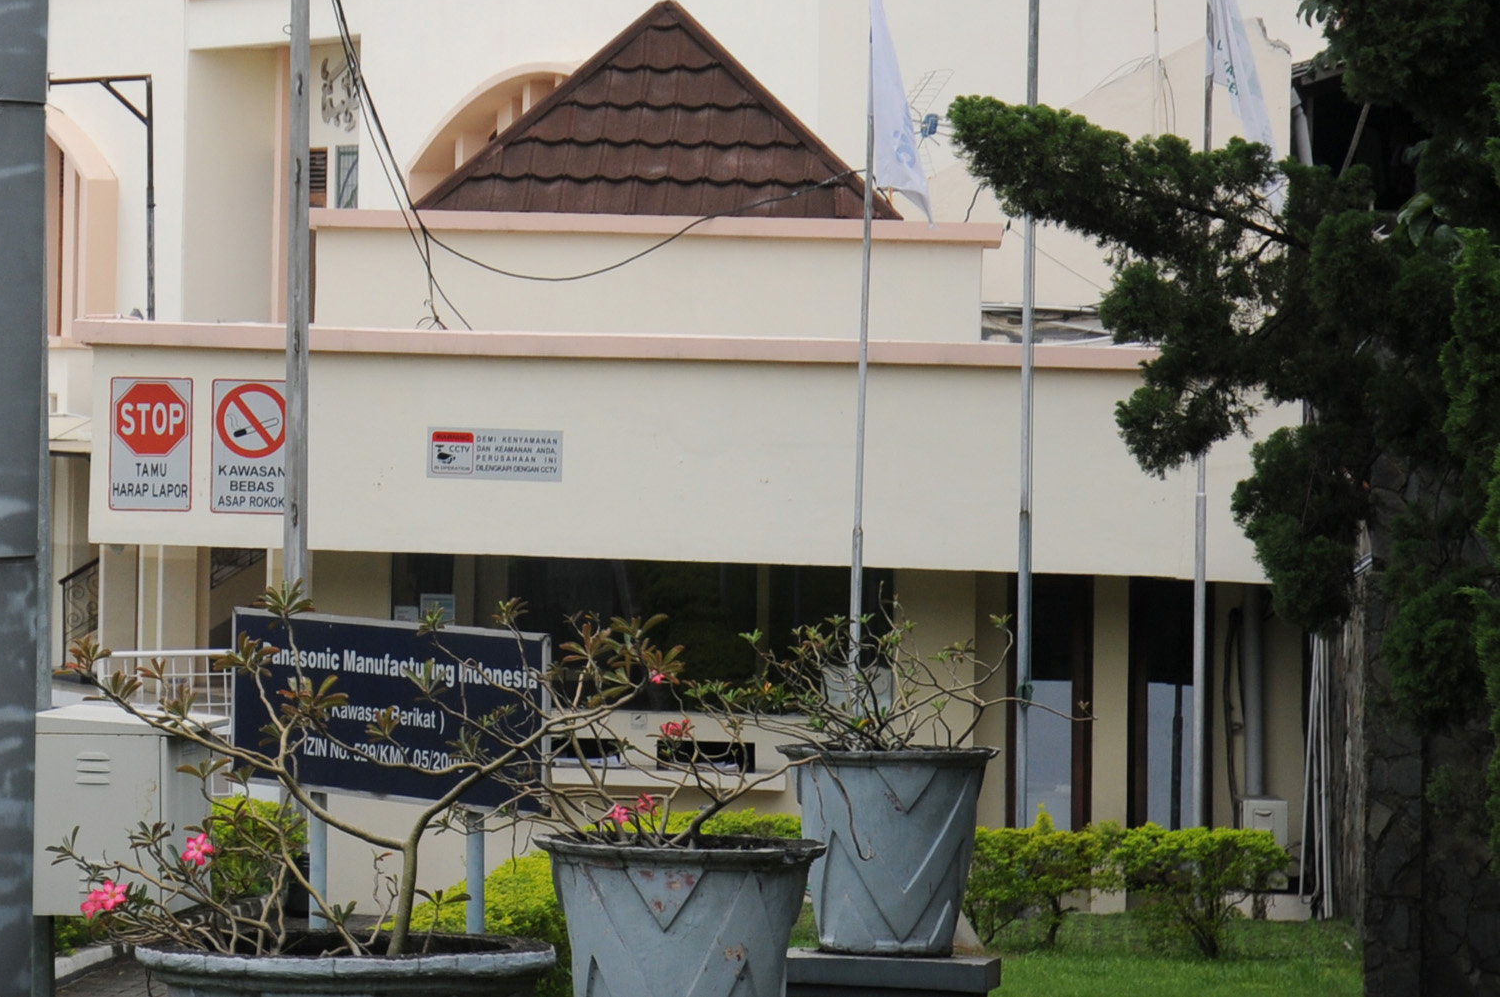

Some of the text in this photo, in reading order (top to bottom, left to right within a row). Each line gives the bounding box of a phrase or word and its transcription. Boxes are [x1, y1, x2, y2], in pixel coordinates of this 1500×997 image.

[121, 402, 185, 436] STOP
[476, 435, 558, 445] DEMI KENYAMANAN
[449, 445, 470, 453] CCTV
[495, 446, 533, 454] KEAMANAN
[476, 455, 536, 463] PERUSAHAAN
[135, 463, 167, 477] TAMU
[218, 465, 285, 478] KAWASAN
[513, 465, 539, 473] DENGAN
[540, 466, 557, 474] CCTV
[113, 482, 188, 498] HARAP LAPOR
[230, 480, 274, 492] BEBAS
[217, 495, 285, 508] ASAP ROKOK
[343, 649, 455, 688] Manufactuing
[458, 662, 538, 689] Indonesia
[391, 705, 436, 729] Berikat
[303, 737, 328, 758] IZIN
